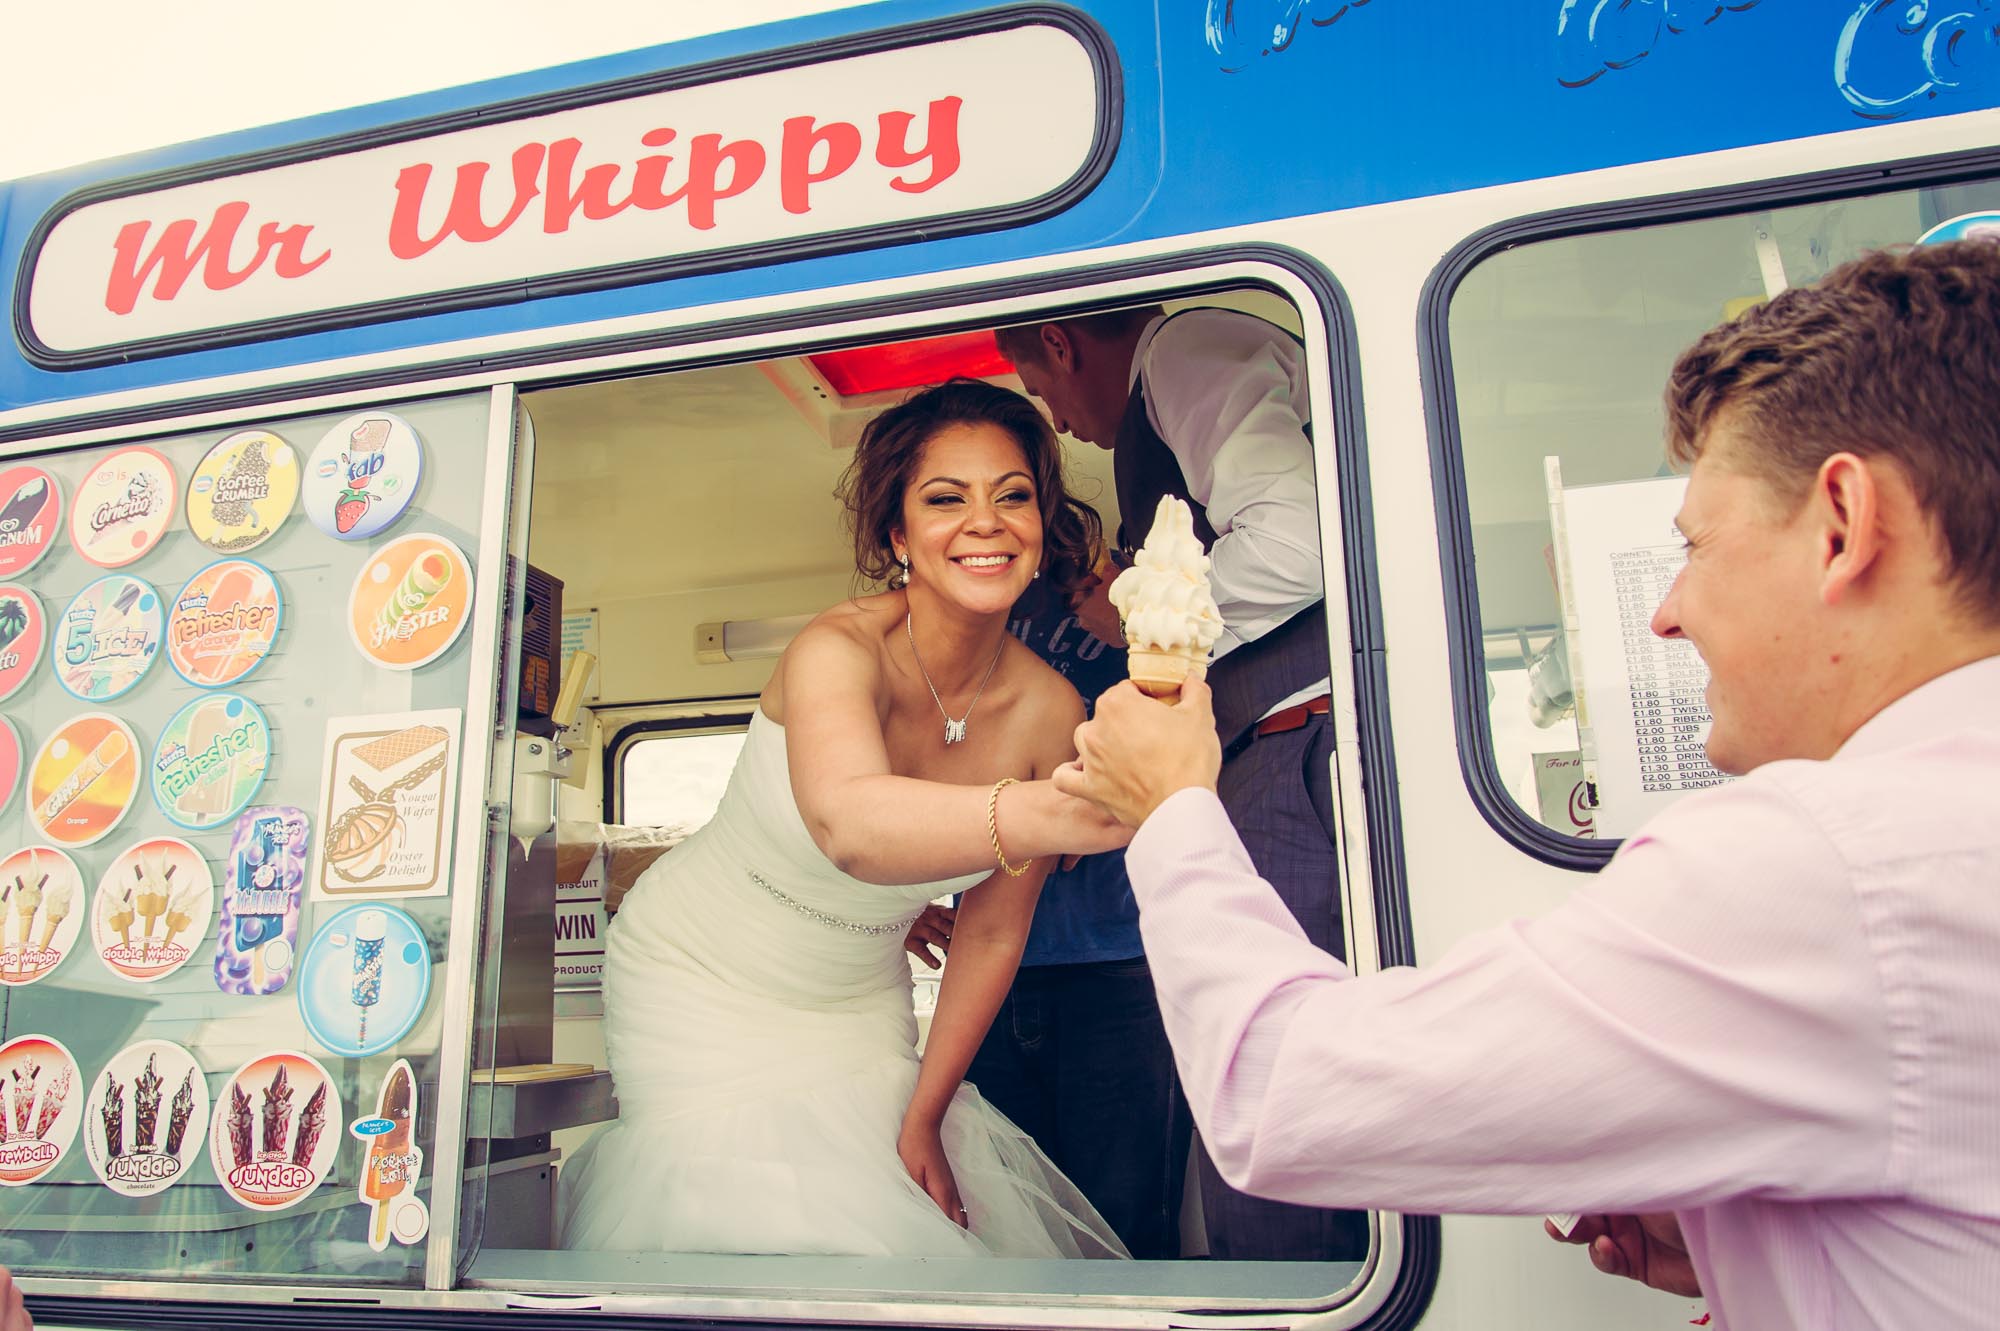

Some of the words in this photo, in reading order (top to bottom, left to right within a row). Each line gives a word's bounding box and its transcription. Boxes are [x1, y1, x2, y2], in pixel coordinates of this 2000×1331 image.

[105, 199, 331, 316] Mr
[388, 94, 964, 261] Whippy
[348, 452, 385, 481] fab
[217, 473, 266, 491] toffee
[213, 485, 269, 504] CRUMBLE
[90, 497, 152, 531] Cornetto
[1609, 550, 1652, 559] CORNETS
[1656, 556, 1686, 564] CORN
[1613, 567, 1649, 577] DOUBLE
[173, 602, 275, 647] refresher
[370, 605, 450, 649] TWISTER
[65, 622, 94, 665] 5
[91, 627, 149, 662] ICE
[1663, 643, 1693, 651] SCRE
[1631, 690, 1659, 699] £1.80
[1669, 687, 1706, 696] STRAW
[1632, 699, 1660, 708] £1.80
[1669, 696, 1706, 705] TOFFE
[1633, 708, 1661, 717] £1.80
[1635, 717, 1662, 726] £1.80
[1673, 714, 1713, 723] RIBENA
[1636, 726, 1664, 735] £2.00
[1672, 724, 1700, 733] TUBS
[1637, 736, 1665, 745] £1.80
[1673, 734, 1695, 742] ZAP
[1639, 745, 1667, 754] £2.00
[1674, 742, 1705, 752] CLOW
[160, 720, 259, 805] refresher
[1640, 754, 1668, 763] £1.50
[1677, 752, 1706, 761] DRIN
[1641, 763, 1669, 772] £1.30
[1678, 761, 1712, 770] BOTTL
[1642, 773, 1671, 782] £2.00
[1643, 782, 1672, 791] £2.50
[399, 792, 438, 803] Nougat
[402, 806, 436, 819] Wafer
[66, 817, 89, 825] Orange
[389, 851, 424, 864] Oyster
[388, 863, 427, 877] Delight
[103, 946, 144, 961] double
[553, 965, 604, 975] PRODUCT
[126, 1182, 156, 1190] chocolate
